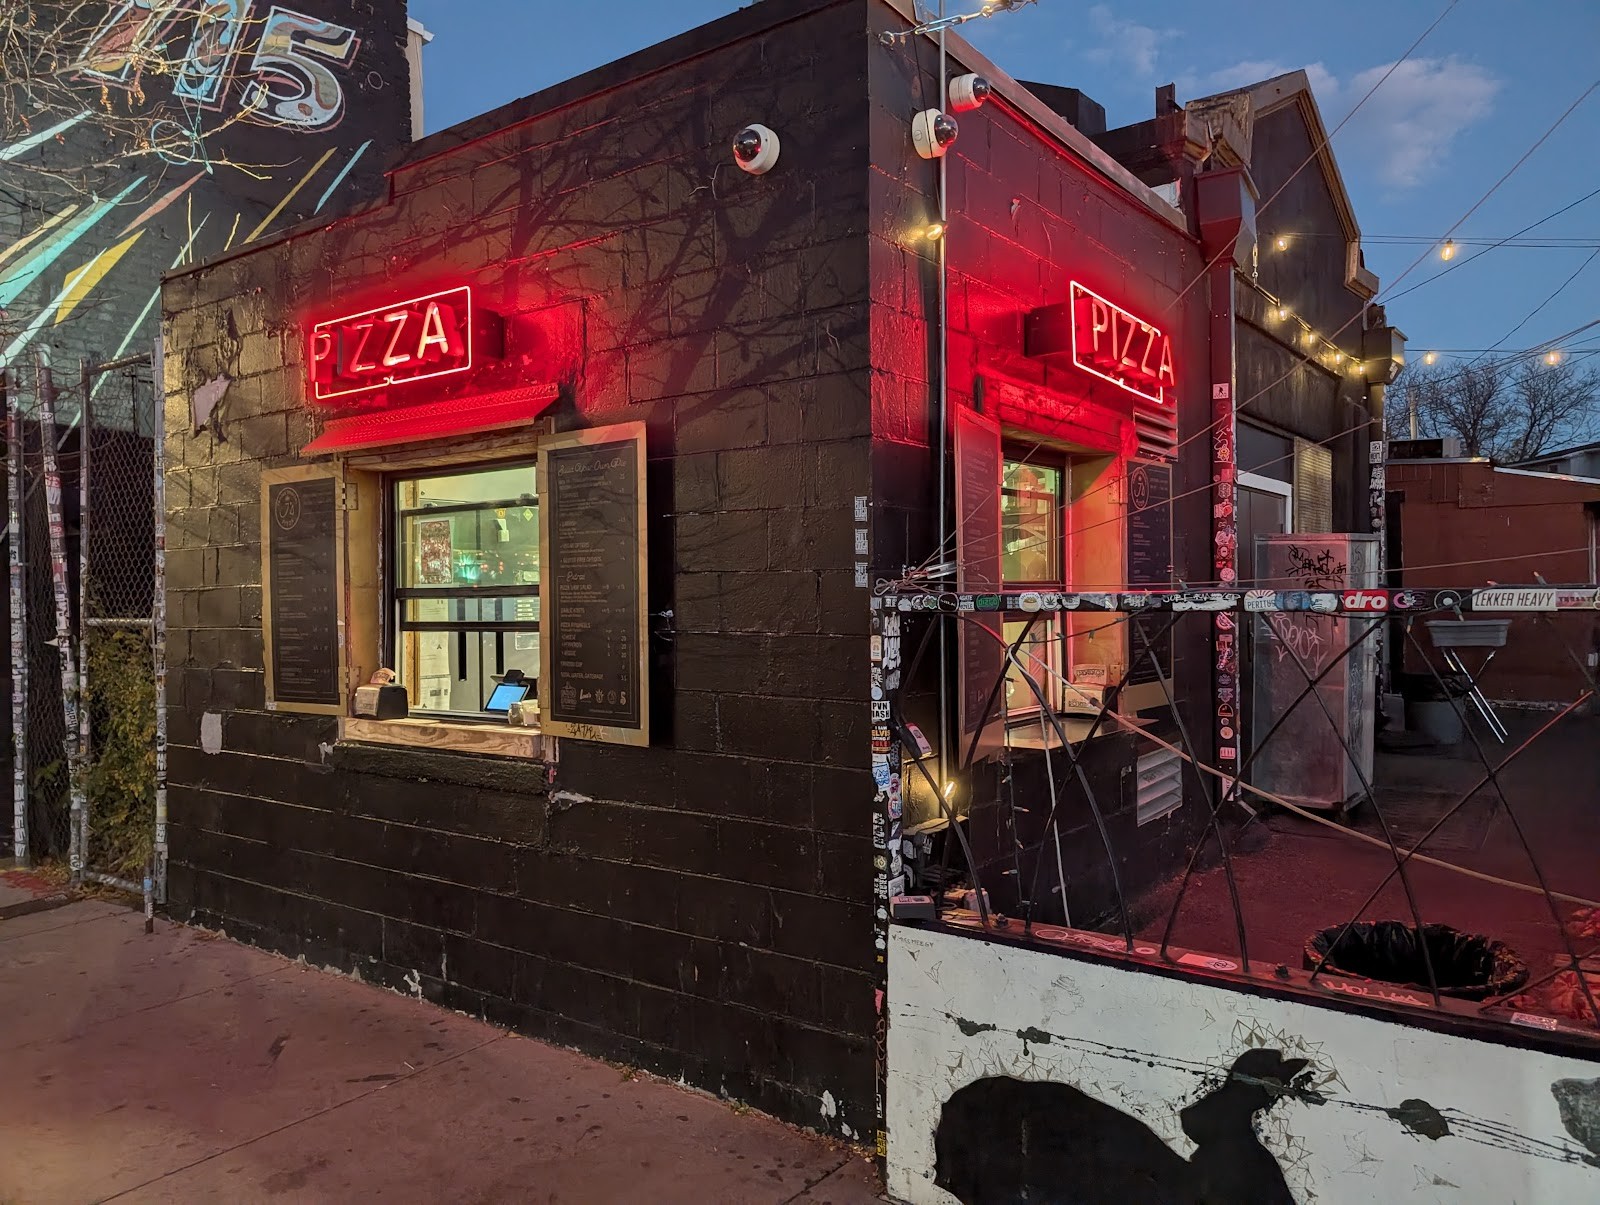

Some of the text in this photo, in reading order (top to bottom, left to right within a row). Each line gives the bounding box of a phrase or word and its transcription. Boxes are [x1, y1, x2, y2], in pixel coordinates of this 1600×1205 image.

[309, 301, 449, 383] PIZZA
[1091, 298, 1175, 387] PIZZA
[1345, 592, 1387, 609] dro
[1475, 592, 1554, 607] LEKKER HEAVY
